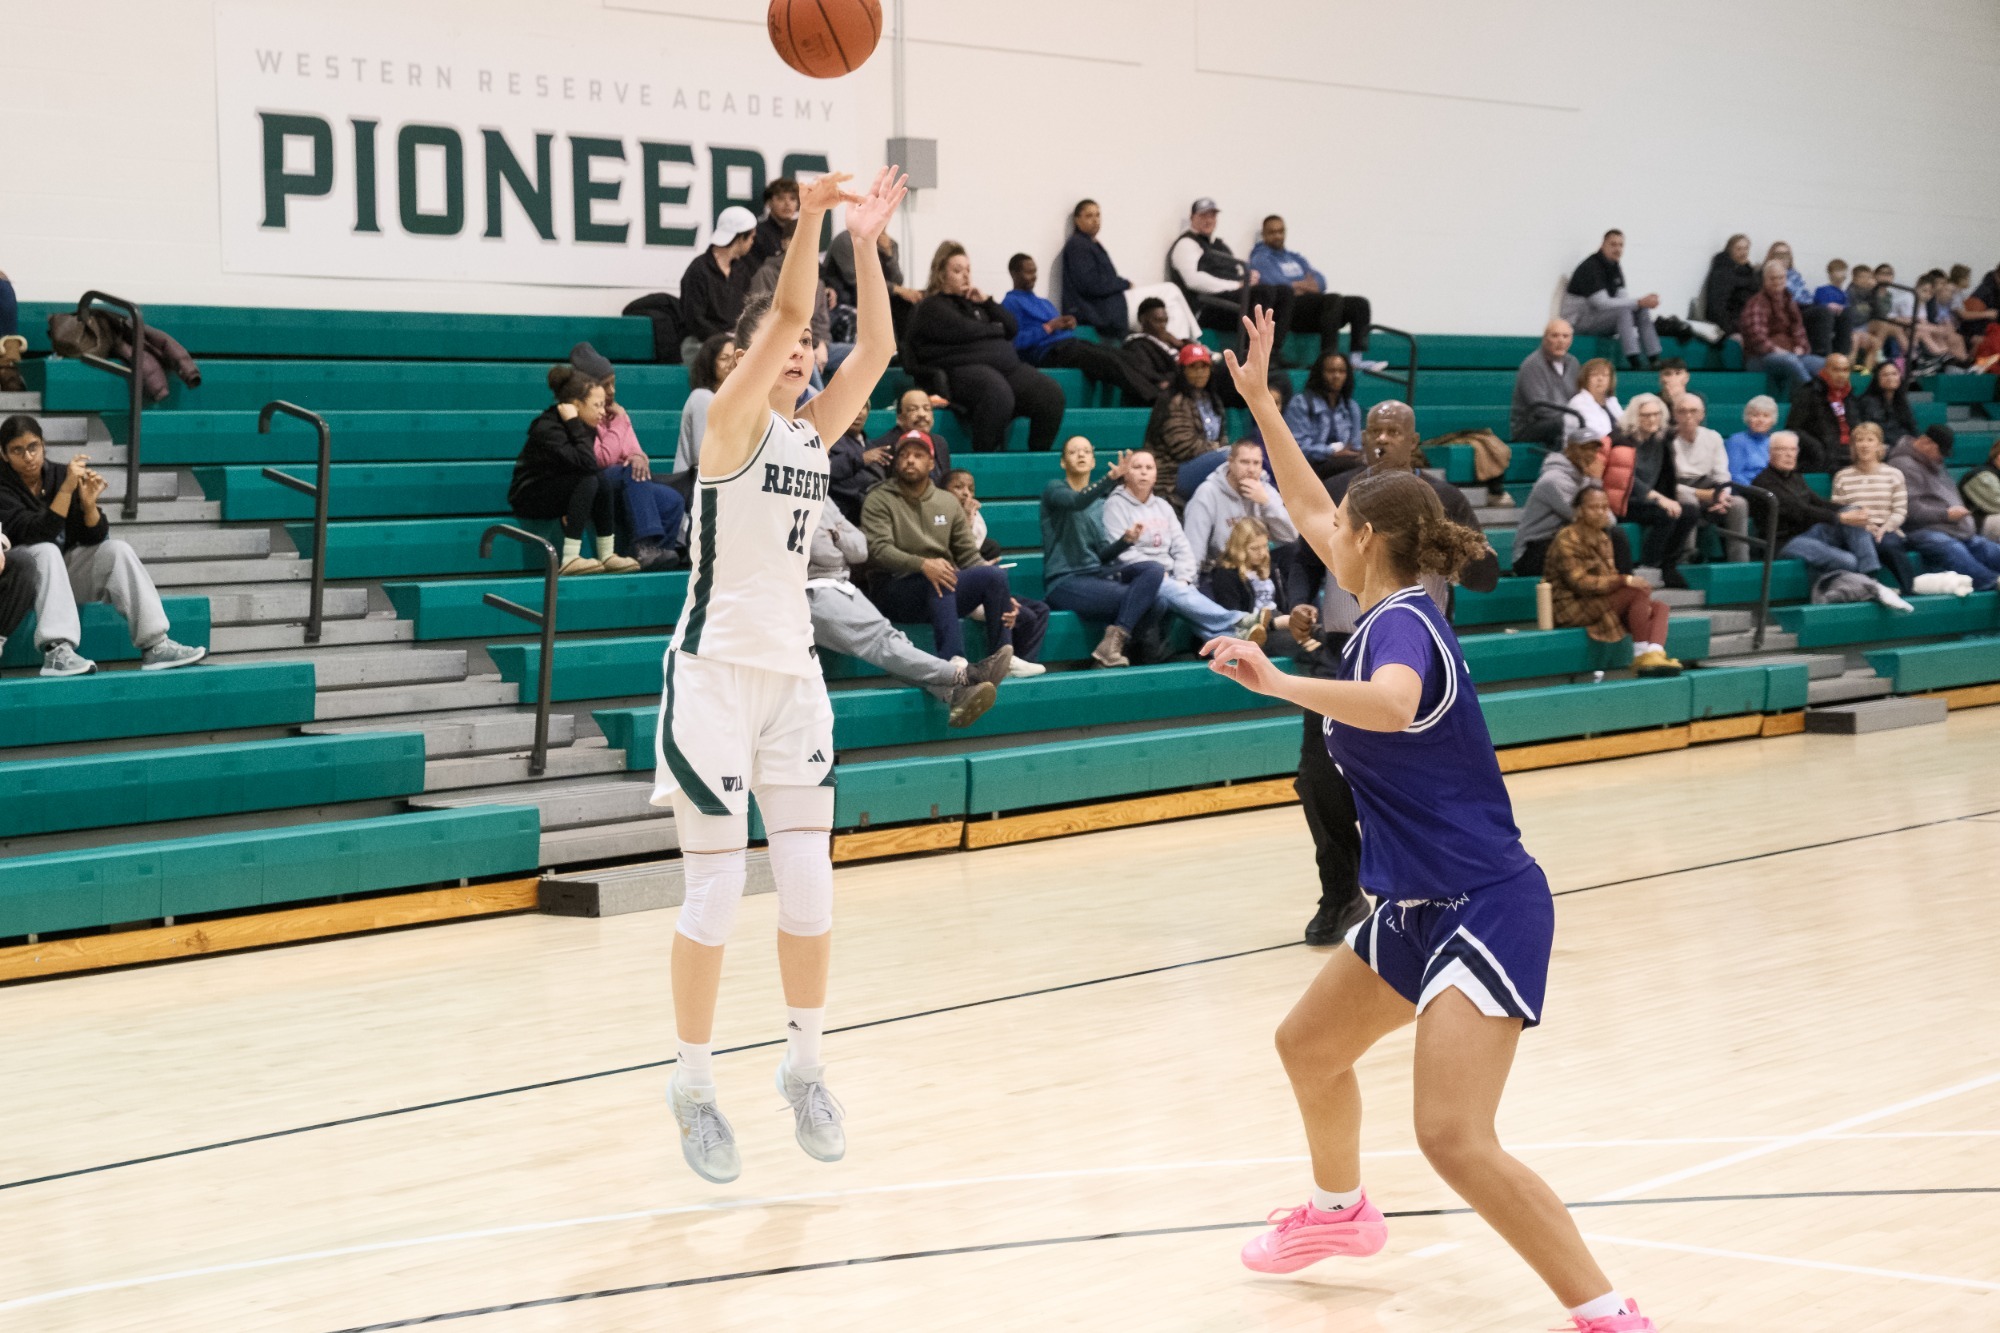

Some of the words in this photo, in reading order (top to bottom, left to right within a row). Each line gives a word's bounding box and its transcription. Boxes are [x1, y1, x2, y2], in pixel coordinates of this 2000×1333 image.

[255, 48, 451, 90] WESTERN
[478, 69, 651, 106] RESERVE
[671, 87, 834, 122] ACADEMY
